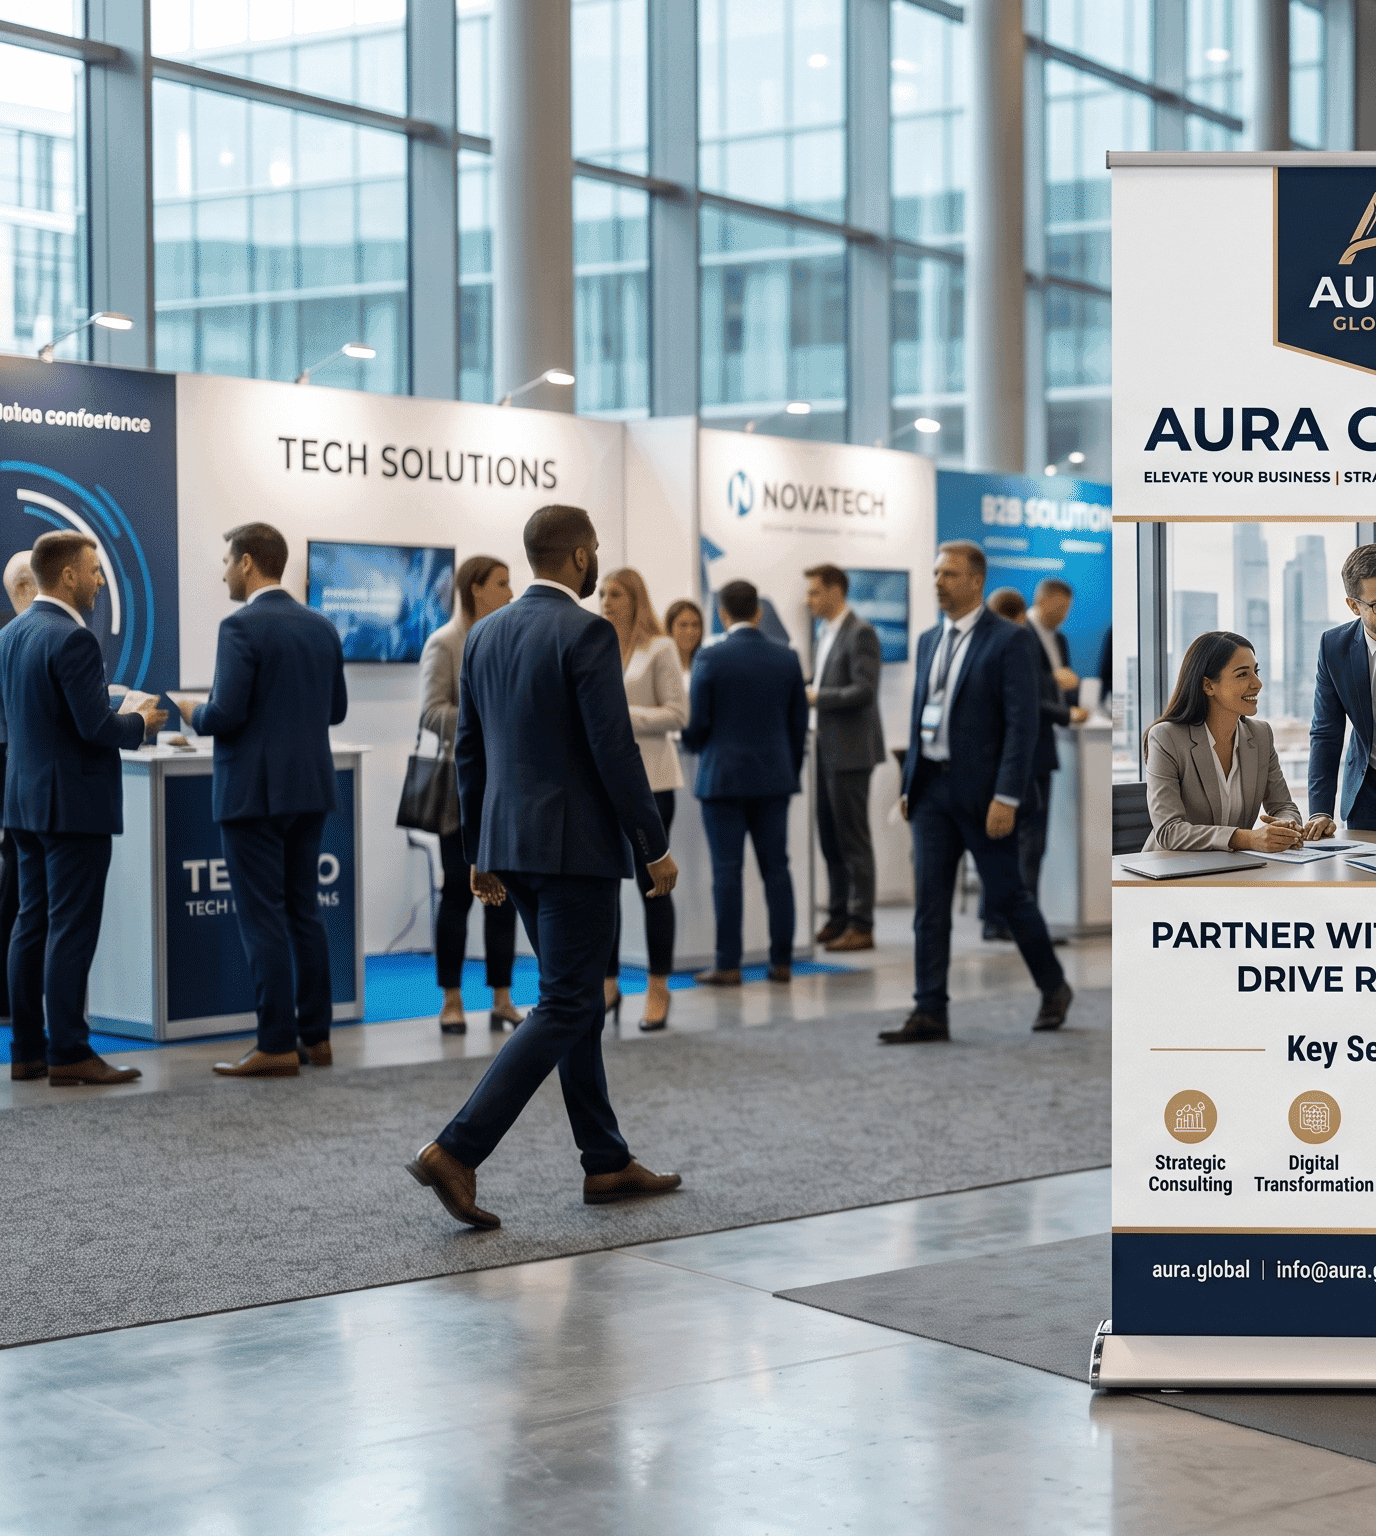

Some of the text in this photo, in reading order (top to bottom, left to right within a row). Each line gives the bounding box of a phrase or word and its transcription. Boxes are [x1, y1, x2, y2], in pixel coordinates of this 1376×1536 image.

[1144, 407, 1330, 452] AURA
[278, 437, 558, 489] TECH SOLUTIONS
[1143, 471, 1209, 484] ELEVATE
[1211, 471, 1254, 484] YOUR
[1258, 471, 1331, 484] BUSINESS
[764, 481, 886, 517] NOVATECH
[185, 900, 228, 917] TECH
[1152, 921, 1315, 949] PARTNER
[1238, 965, 1344, 993] DRIVE
[1287, 1034, 1338, 1069] Key
[1155, 1154, 1226, 1175] Strategic
[1288, 1154, 1339, 1175] Digital
[1148, 1175, 1233, 1196] Consulting
[1254, 1175, 1374, 1193] Transformation
[1152, 1259, 1250, 1282] aura.global
